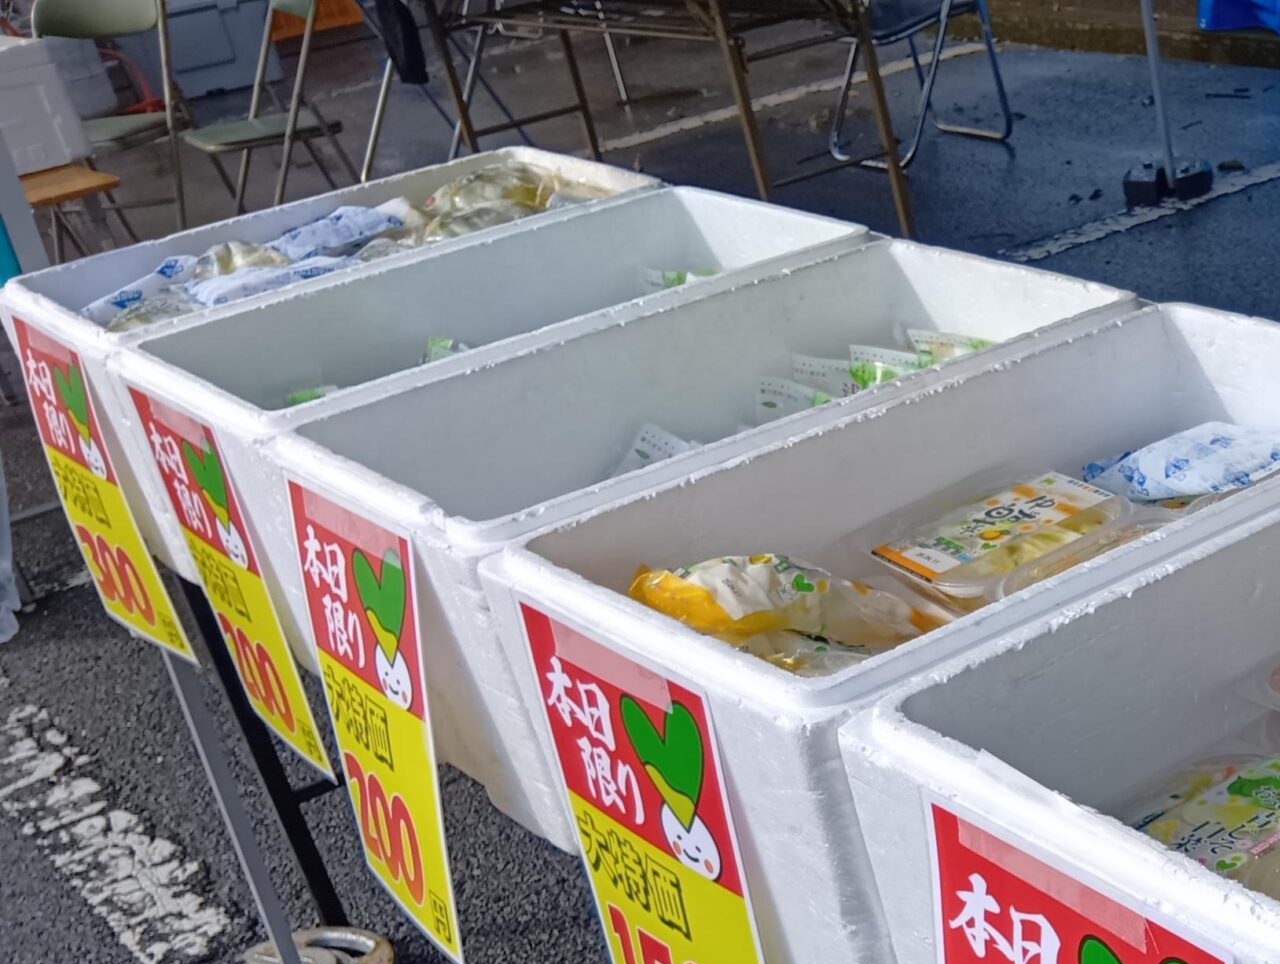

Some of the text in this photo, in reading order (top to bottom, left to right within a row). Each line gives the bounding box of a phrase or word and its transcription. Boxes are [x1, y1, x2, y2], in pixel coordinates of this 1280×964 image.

[25, 348, 56, 405] 本日
[43, 400, 76, 455] 限り
[150, 421, 189, 484] 本日
[172, 480, 212, 540] 限り
[75, 523, 156, 627] 300
[303, 525, 346, 603] 本日
[321, 594, 366, 668] 限り
[216, 611, 297, 735] 200
[546, 654, 616, 751] 本日
[325, 663, 395, 772] 大特価
[577, 744, 645, 825] 限り
[343, 750, 425, 906] 200
[1174, 820, 1226, 853] 白菜
[1211, 811, 1277, 854] 青じそ
[580, 809, 693, 942] 大特価
[429, 888, 453, 944] 円
